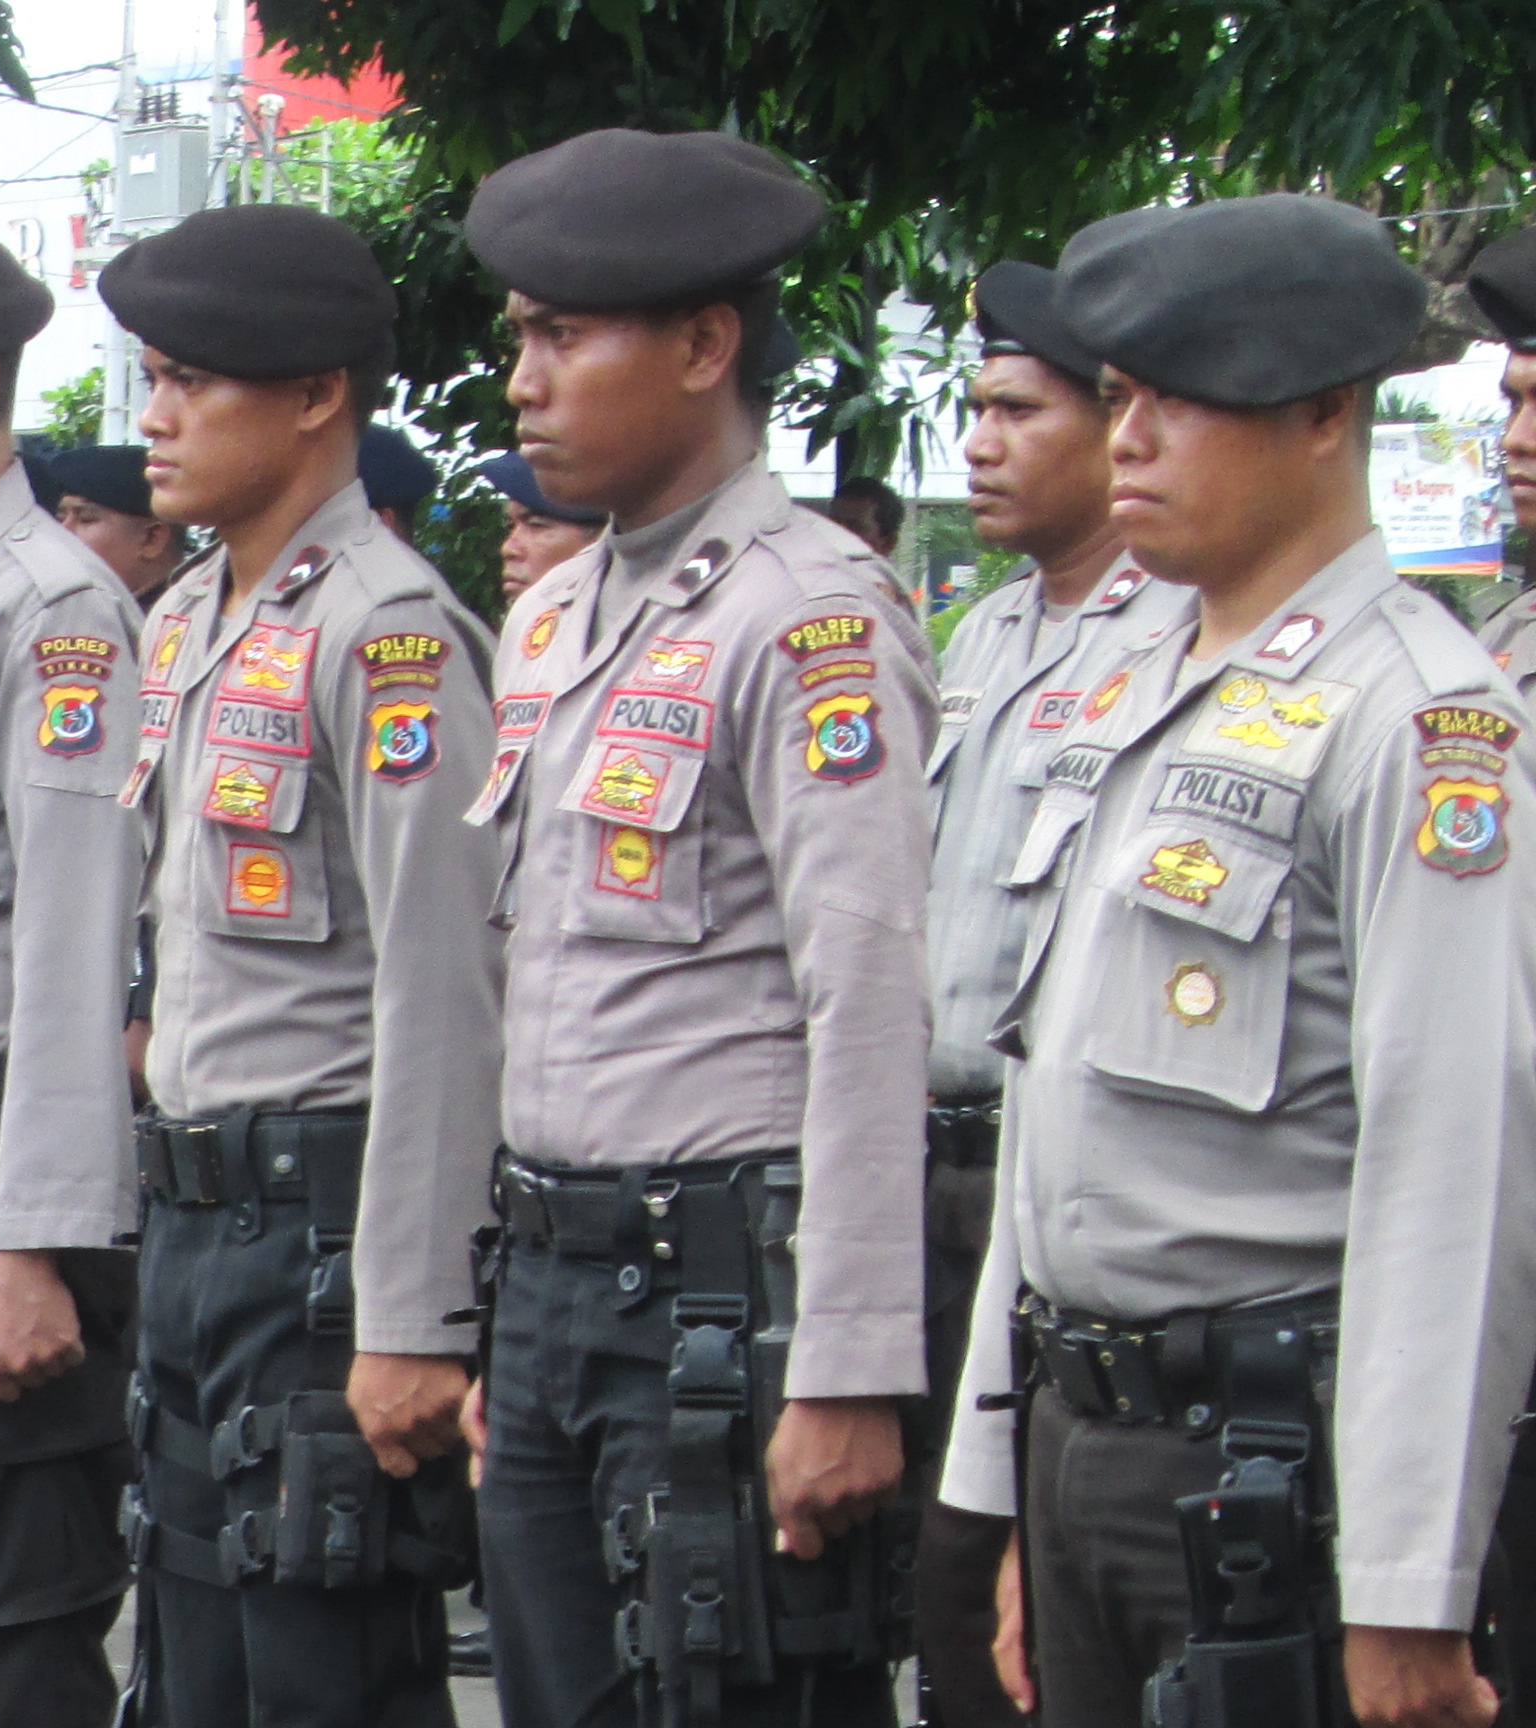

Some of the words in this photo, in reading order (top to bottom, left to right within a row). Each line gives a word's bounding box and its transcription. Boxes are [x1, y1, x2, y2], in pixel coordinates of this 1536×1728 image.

[40, 637, 110, 656] POLRES
[788, 617, 865, 649] POLRES
[363, 635, 442, 660] POLRES
[44, 661, 104, 675] SIKKA
[217, 705, 298, 745] POLISI
[610, 698, 700, 738] POLISI
[1423, 710, 1508, 734] POLRES
[1170, 768, 1268, 820] POLISI
